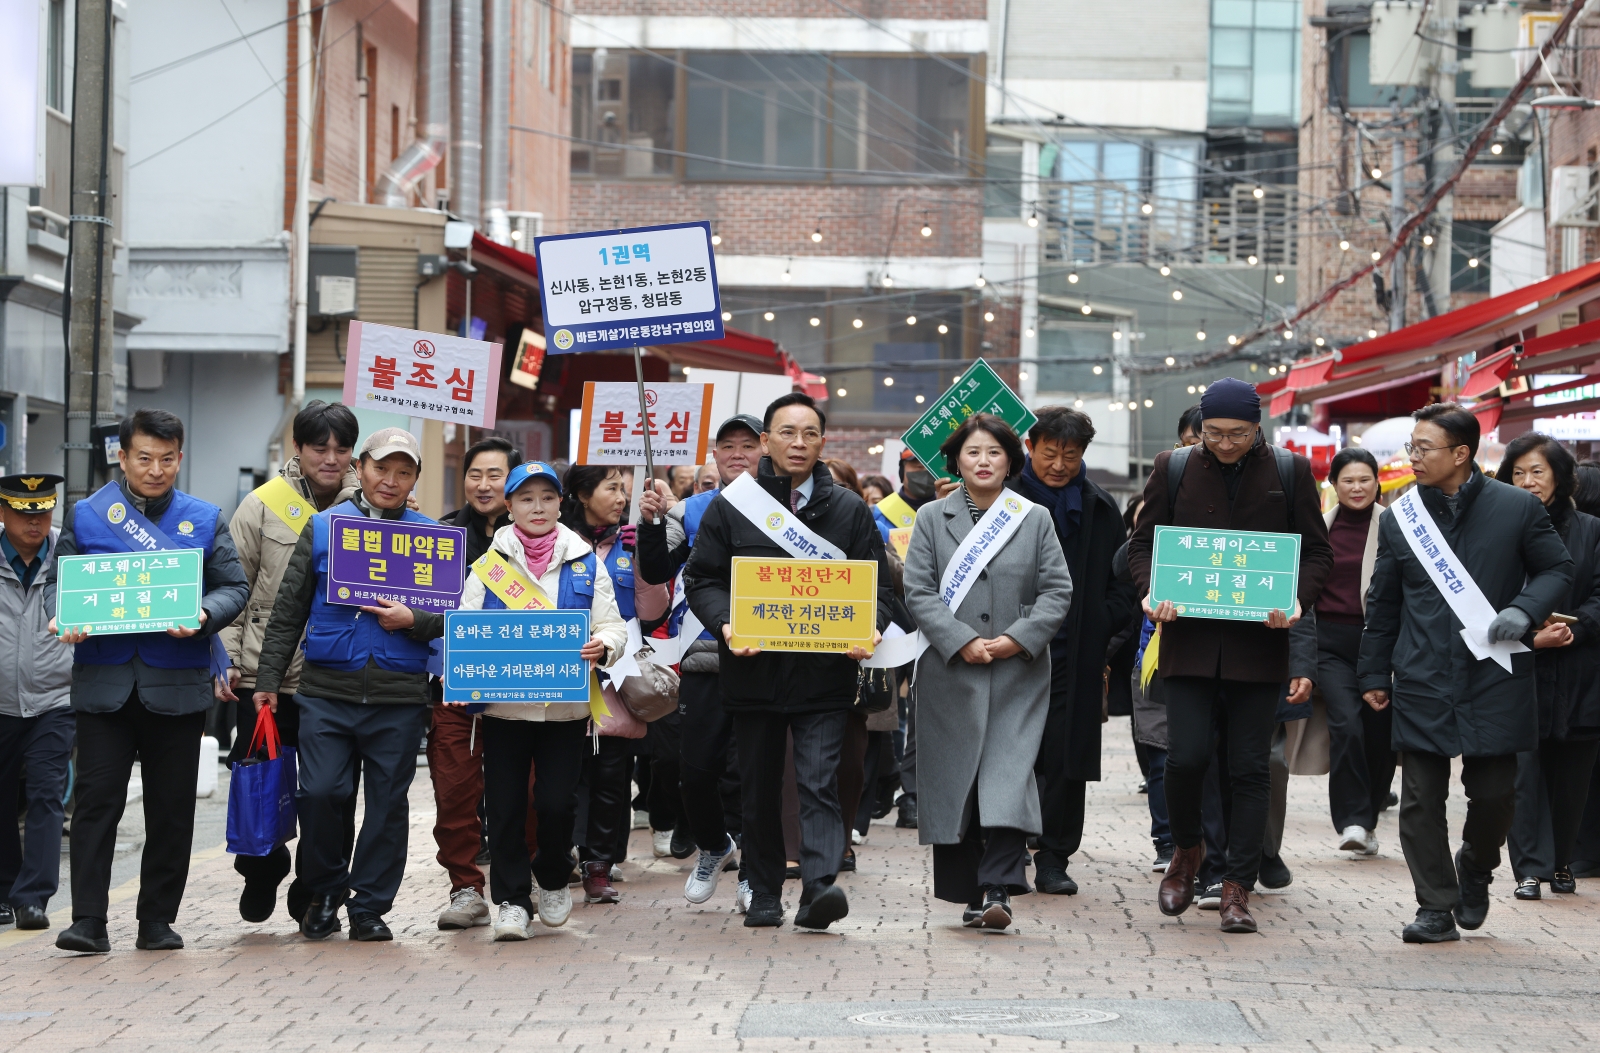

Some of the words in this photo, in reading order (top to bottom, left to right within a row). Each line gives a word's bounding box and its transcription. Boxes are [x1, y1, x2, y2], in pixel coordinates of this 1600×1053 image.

[599, 243, 650, 265] 1권역
[551, 278, 594, 295] 신사동,
[599, 272, 652, 290] 논현1동,
[657, 267, 707, 285] 논현2동
[579, 295, 638, 314] 압구정동,
[642, 291, 682, 308] 청담동
[920, 378, 980, 438] 제로웨이스트
[342, 528, 381, 553] 불법
[392, 533, 454, 560] 마약류
[783, 527, 818, 556] 강남구
[1178, 535, 1277, 552] 제로웨이스트
[82, 558, 180, 574] 제로웨이스트
[756, 566, 851, 584] 불법전단지
[1435, 558, 1465, 594] 봉사단
[790, 585, 819, 596] NO
[752, 603, 794, 620] 깨끗한
[800, 604, 856, 622] 거리문화
[454, 625, 493, 638] 올바른
[498, 624, 523, 638] 건설
[528, 624, 581, 638] 문화정착
[787, 623, 820, 634] YES
[454, 664, 498, 678] 아름다운
[501, 664, 554, 678] 거리문화의
[559, 664, 581, 678] 시작
